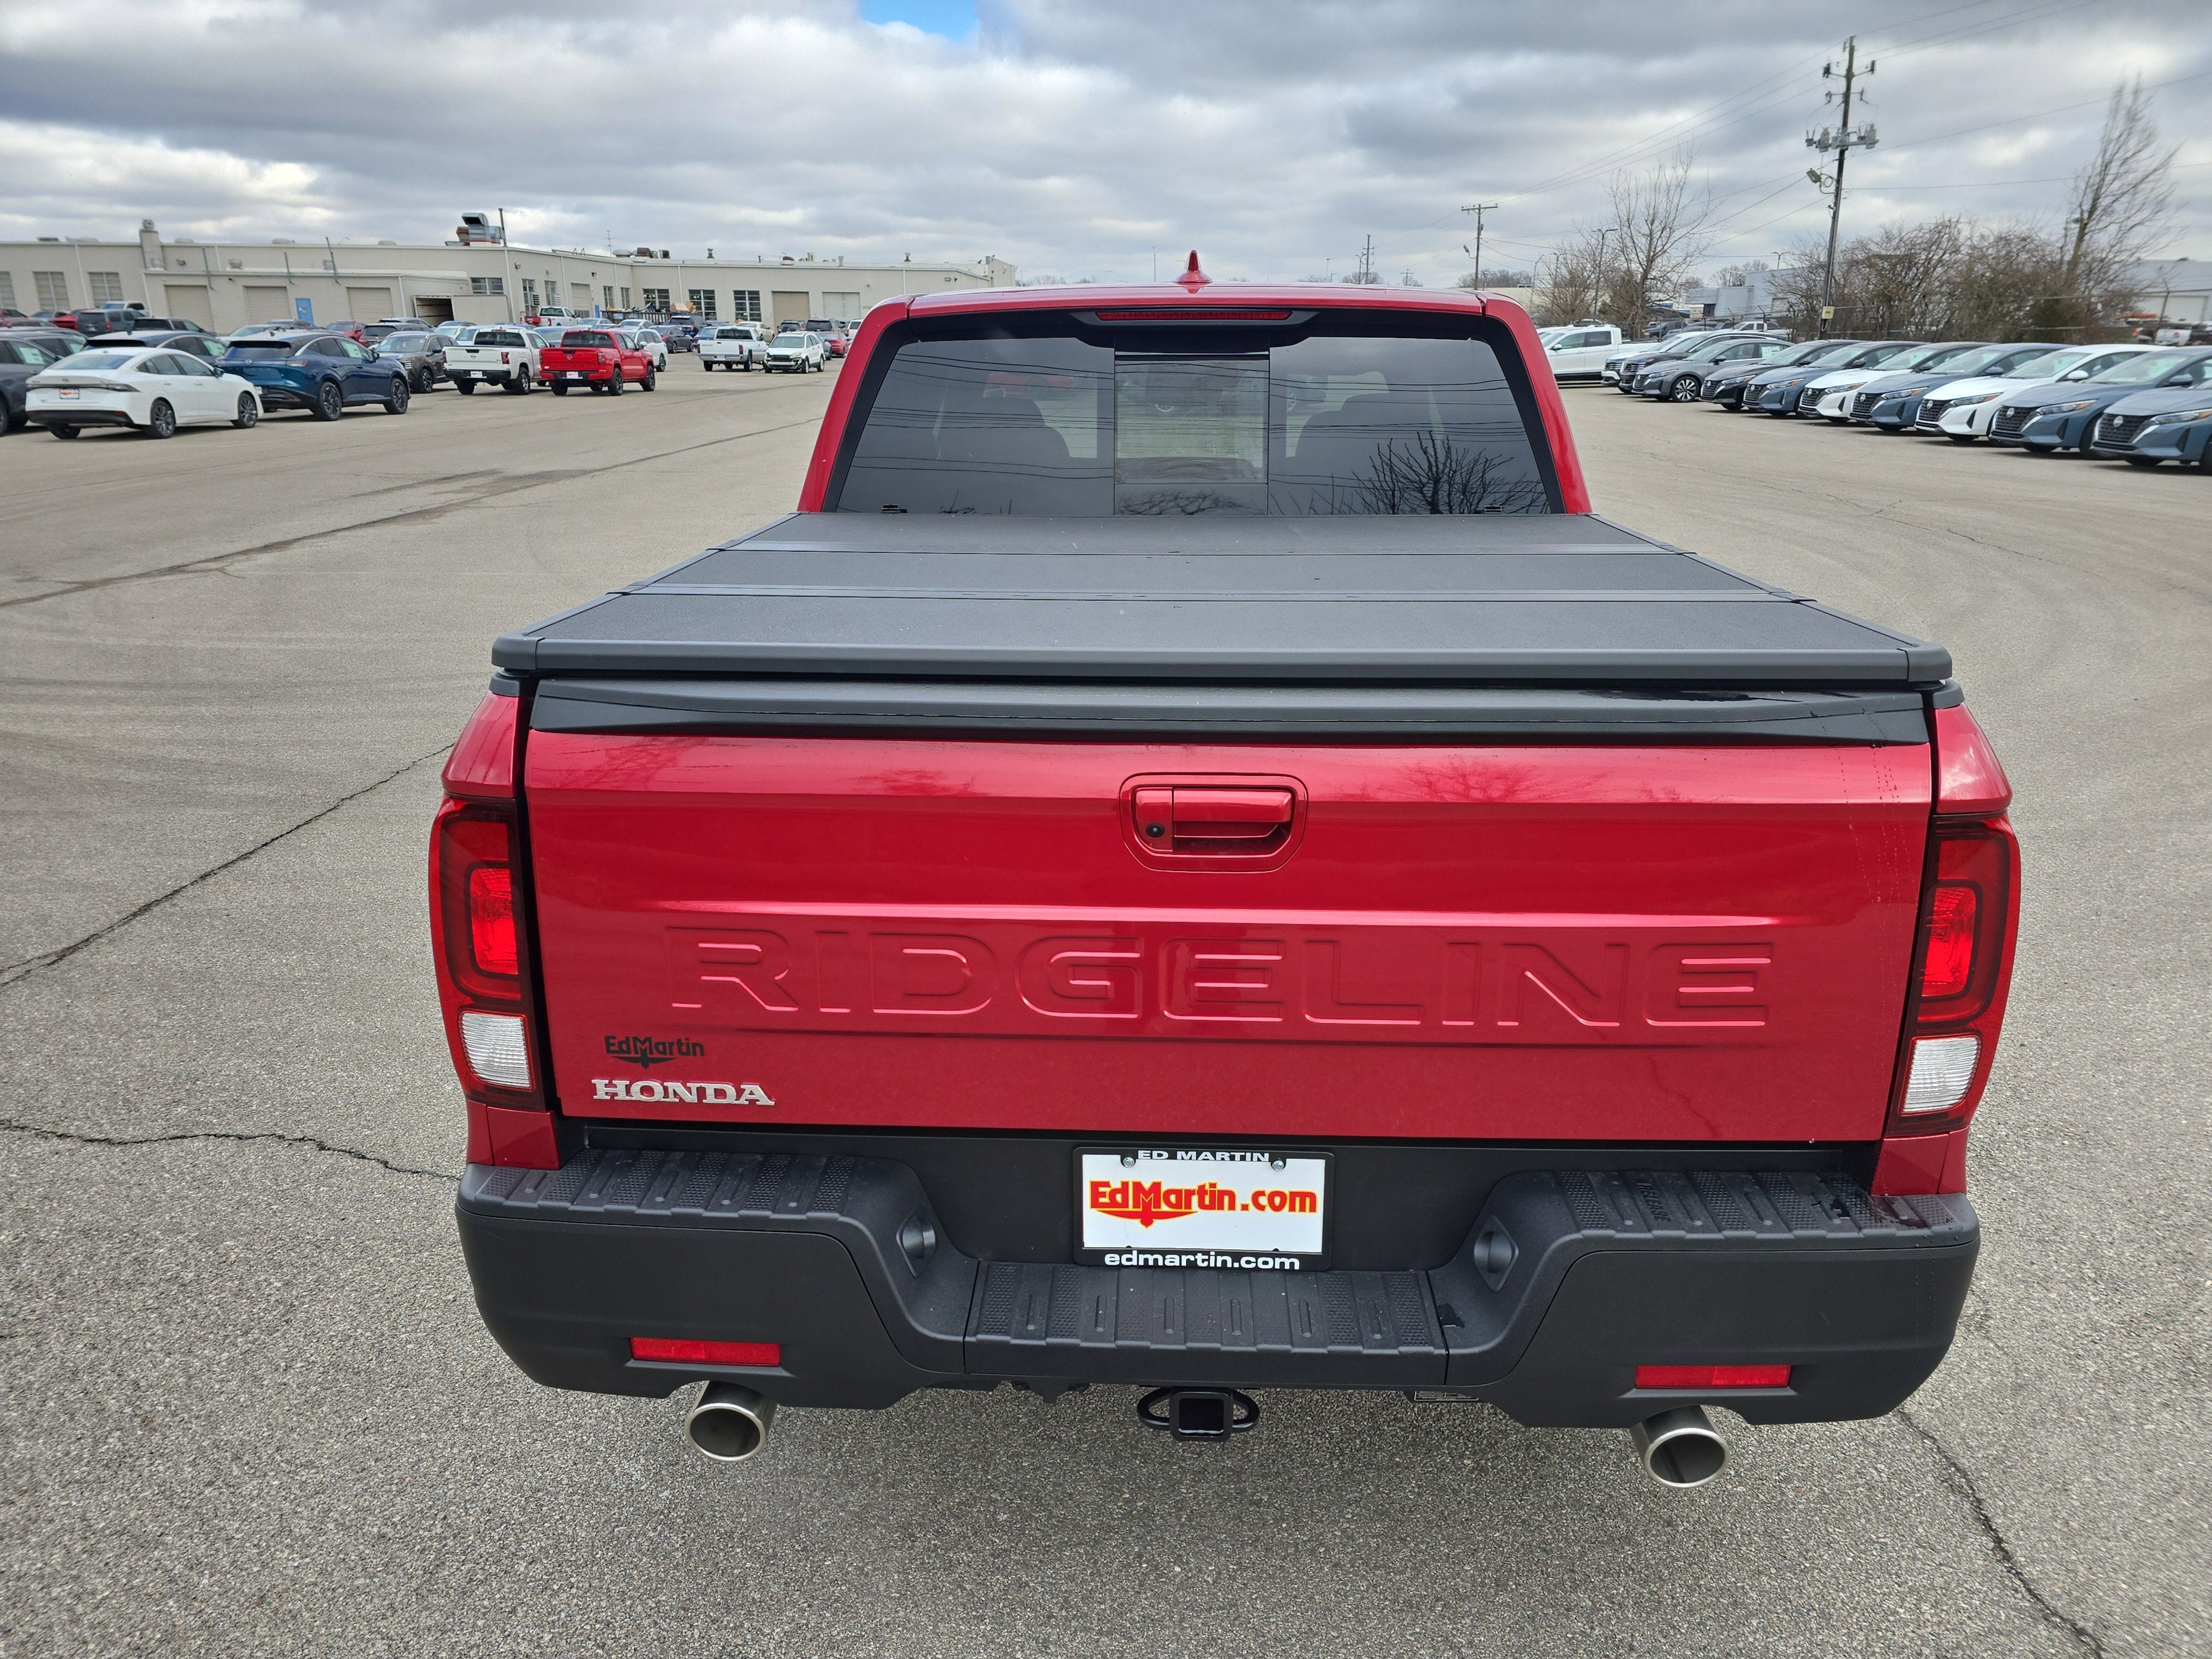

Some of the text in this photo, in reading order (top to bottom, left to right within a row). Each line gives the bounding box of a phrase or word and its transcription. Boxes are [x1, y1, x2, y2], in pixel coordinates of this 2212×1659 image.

[665, 927, 1775, 1027] RIDGELINE
[604, 1036, 704, 1062] EdMartin
[591, 1079, 776, 1105] HONDA
[1137, 1150, 1270, 1162] ED MARTIN
[1089, 1180, 1318, 1219] EdMartin.com
[1104, 1250, 1300, 1270] edmartin.com
